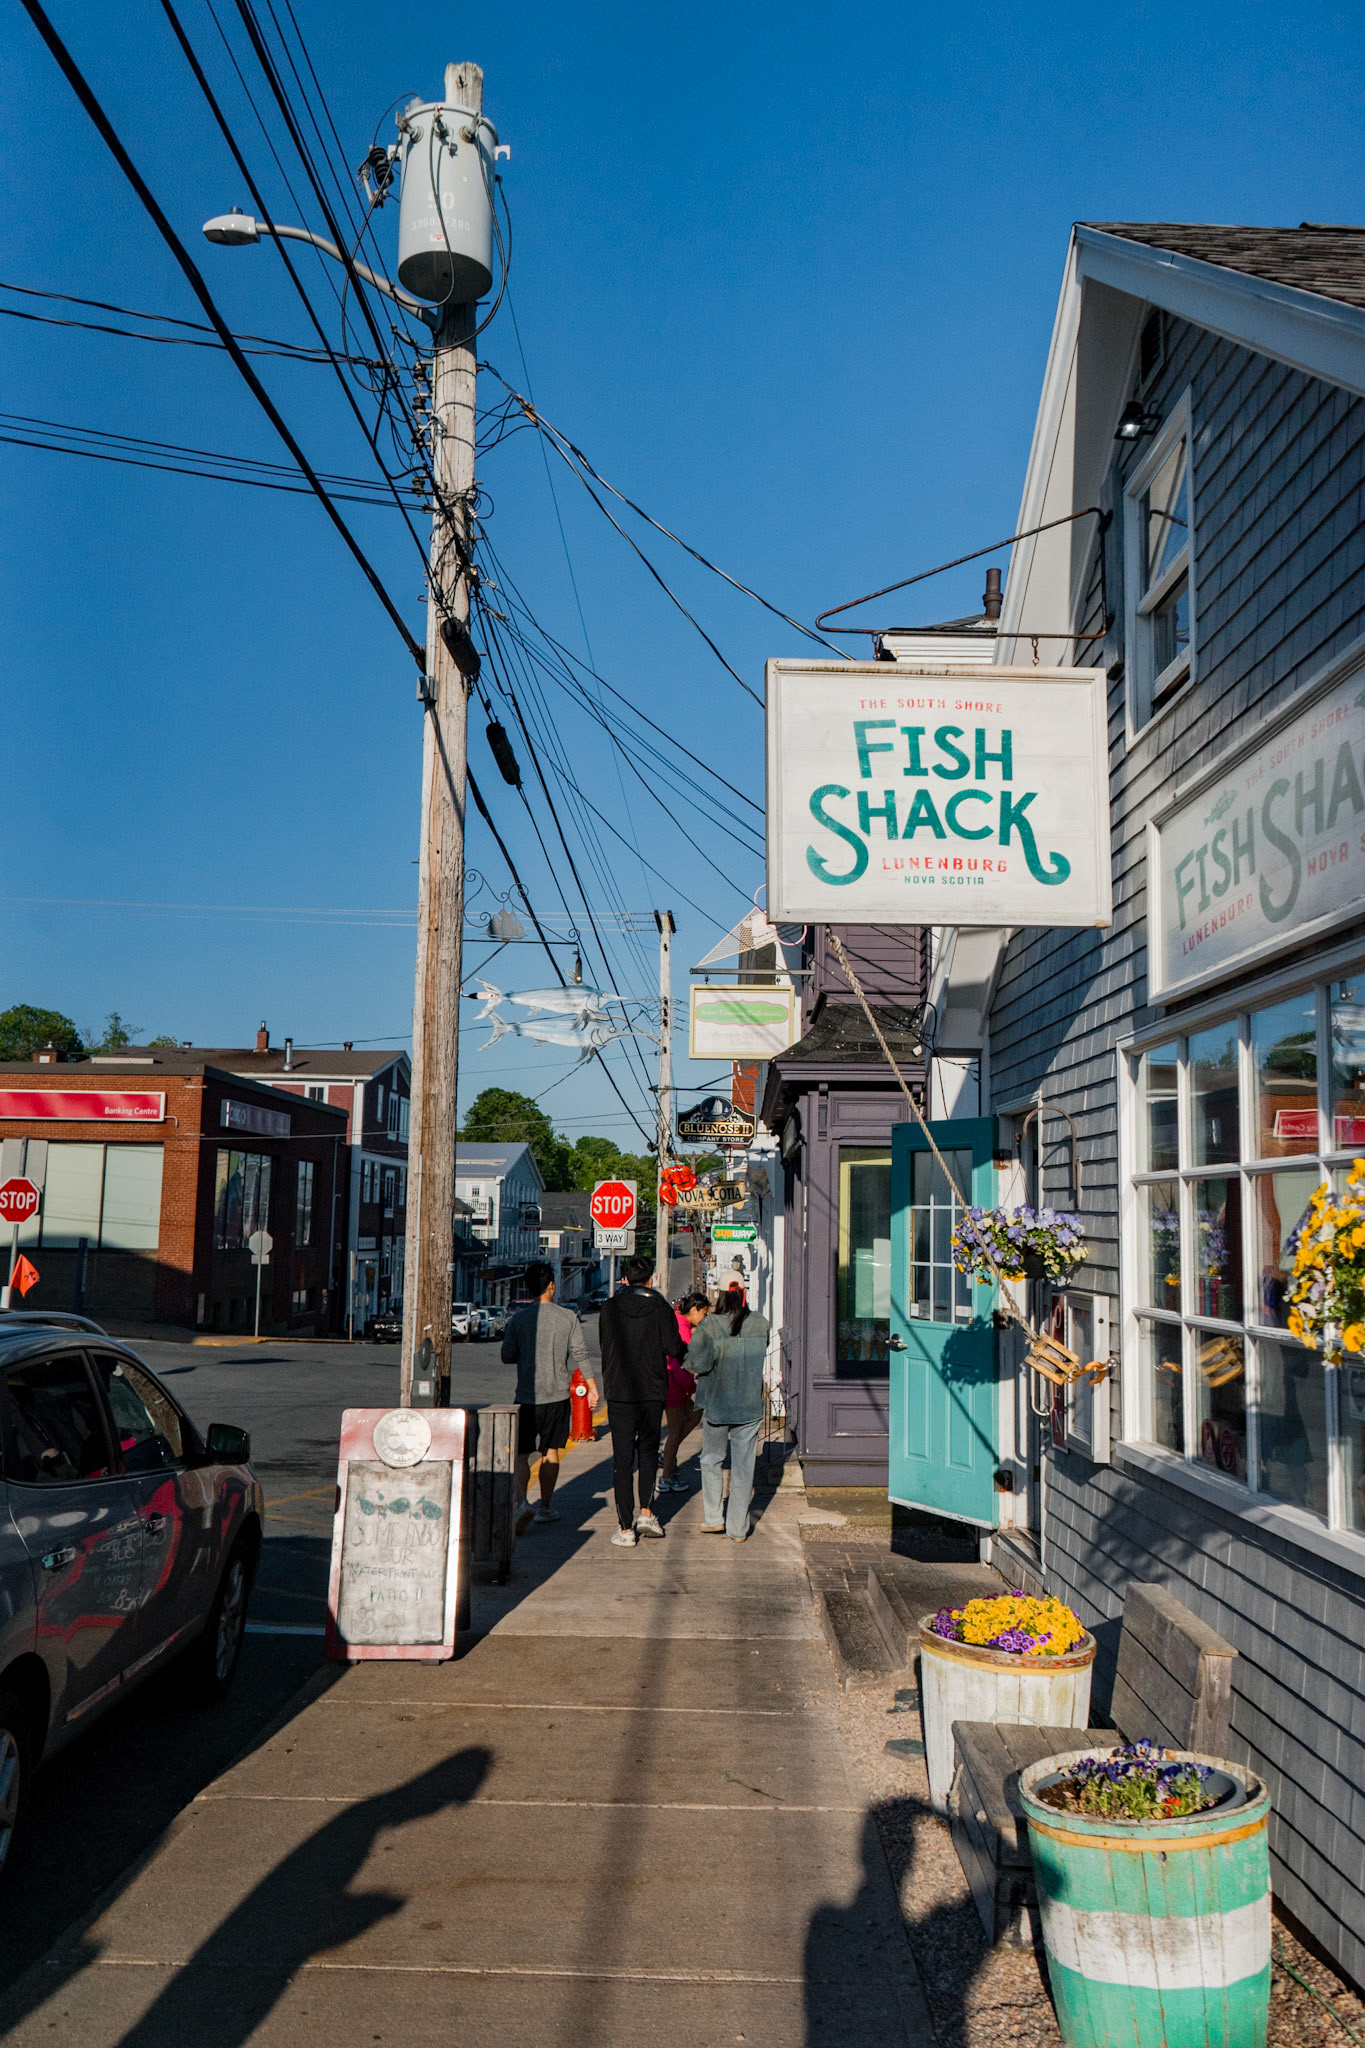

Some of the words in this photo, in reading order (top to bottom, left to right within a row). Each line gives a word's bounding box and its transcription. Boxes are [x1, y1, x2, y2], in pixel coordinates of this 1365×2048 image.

[860, 699, 887, 709] THE
[897, 698, 946, 709] SOUTH
[955, 700, 1003, 713] SHORE
[853, 719, 1013, 781] FISH
[1246, 766, 1264, 791] THE
[806, 784, 1071, 886] SHACK
[1174, 806, 1256, 931] FISH
[1259, 740, 1365, 924] SHA
[882, 856, 1008, 873] LUNENBURG
[904, 875, 935, 885] NOVA
[941, 876, 984, 885] SCOTIA
[1182, 892, 1254, 957] LUNENBURG
[1307, 841, 1349, 878] NOVA
[104, 1106, 133, 1116] Banking
[134, 1107, 158, 1115] Centre
[684, 1123, 740, 1134] BLUENOSE
[742, 1125, 750, 1134] II
[0, 1191, 36, 1210] STOP
[677, 1188, 704, 1203] NOVA
[707, 1187, 742, 1201] SCOTIA
[593, 1195, 632, 1214] STOP
[598, 1234, 603, 1243] 3
[605, 1234, 623, 1243] WAY
[714, 1228, 756, 1239] SUBWAY
[1054, 1304, 1063, 1433] OEN
[379, 1548, 413, 1565] OUR
[370, 1585, 408, 1603] PATIO
